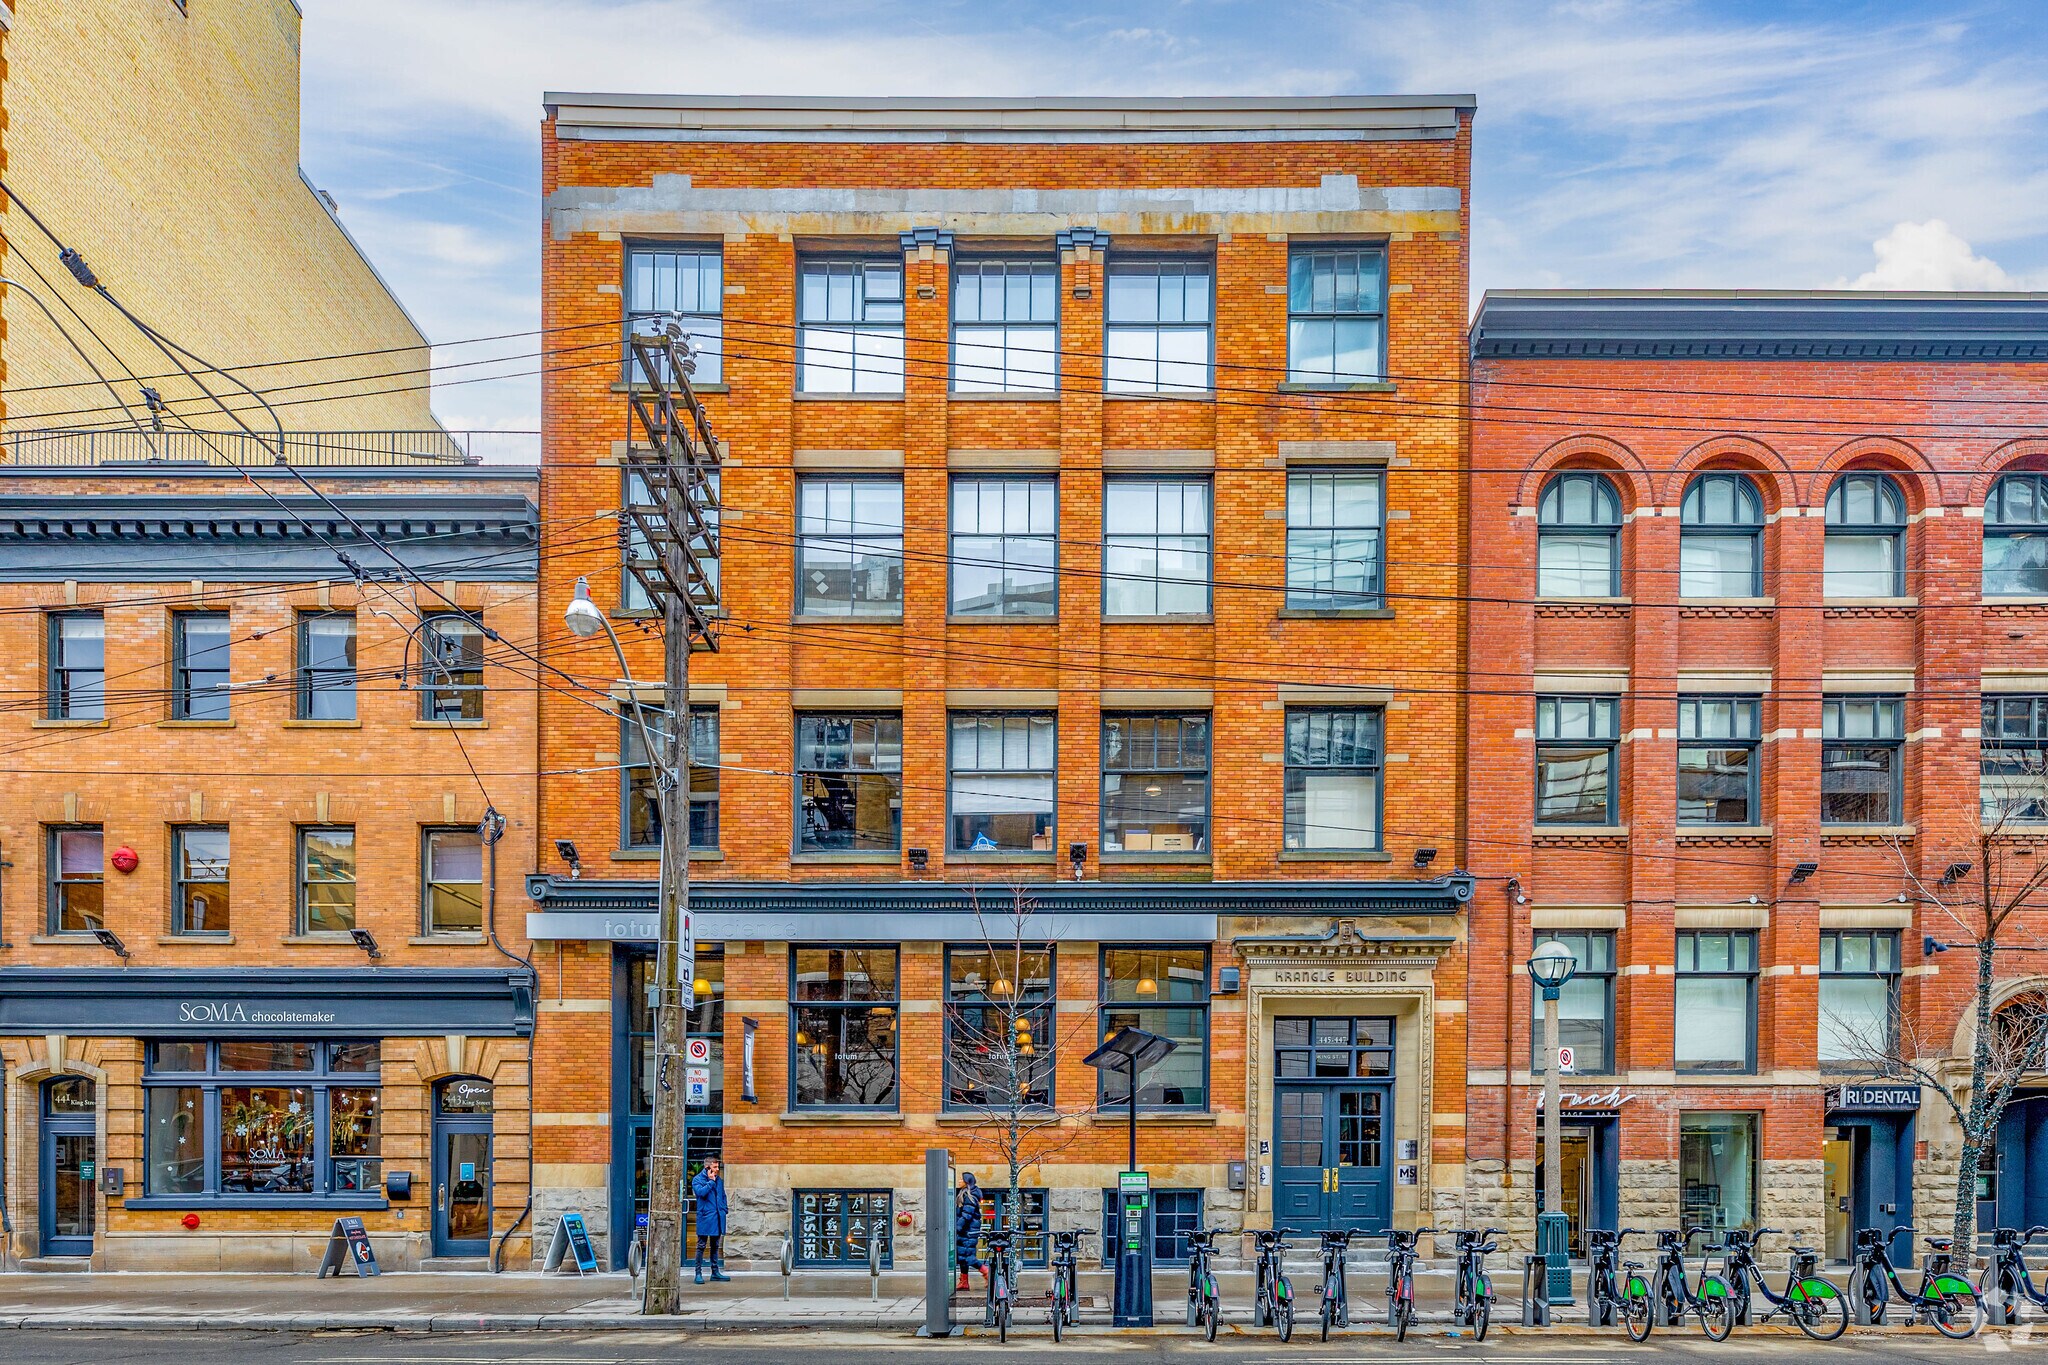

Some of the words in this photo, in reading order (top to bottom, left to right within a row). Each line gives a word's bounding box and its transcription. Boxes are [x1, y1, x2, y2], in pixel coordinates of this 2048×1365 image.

[1275, 971, 1335, 983] KRANGLE
[1346, 971, 1407, 983] BUILDING
[251, 1010, 335, 1022] chocolatemaker
[834, 1052, 858, 1060] totum
[458, 1084, 490, 1099] Open
[1863, 1090, 1920, 1104] DENTAL
[55, 1094, 70, 1104] 441
[803, 1194, 816, 1259] CLASSES
